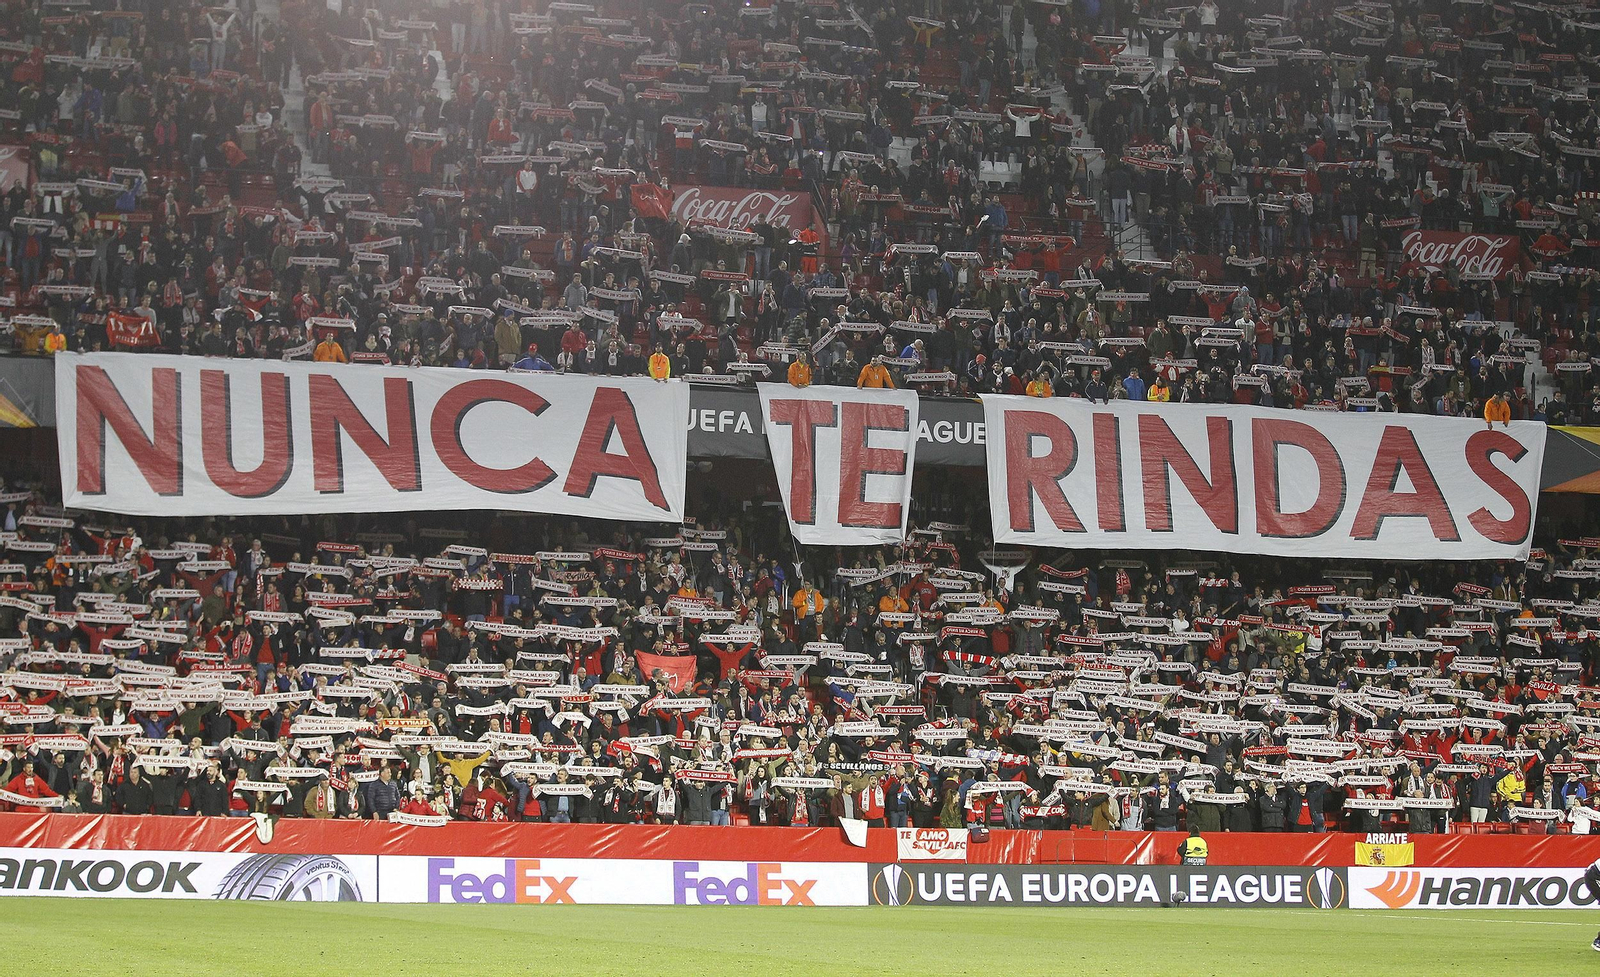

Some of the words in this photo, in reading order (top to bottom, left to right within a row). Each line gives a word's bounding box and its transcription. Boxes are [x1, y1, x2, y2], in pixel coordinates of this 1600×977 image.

[672, 188, 799, 232] Coca-Cola
[1402, 231, 1511, 277] Coca-Cola
[76, 365, 671, 512] NUNCA
[770, 399, 909, 529] TE
[1003, 410, 1531, 545] RINDAS
[1529, 682, 1555, 691] SEVILLA
[1157, 734, 1173, 742] NUNCA
[7, 794, 25, 804] NUNCA
[901, 831, 911, 839] TE
[919, 831, 947, 840] AMO
[1366, 833, 1408, 844] ARRIATE
[428, 858, 578, 904] FedEx
[673, 862, 818, 905] FedEx
[918, 872, 1010, 902] UEFA
[1022, 874, 1160, 902] EUROPA
[1170, 874, 1302, 902] LEAGUE
